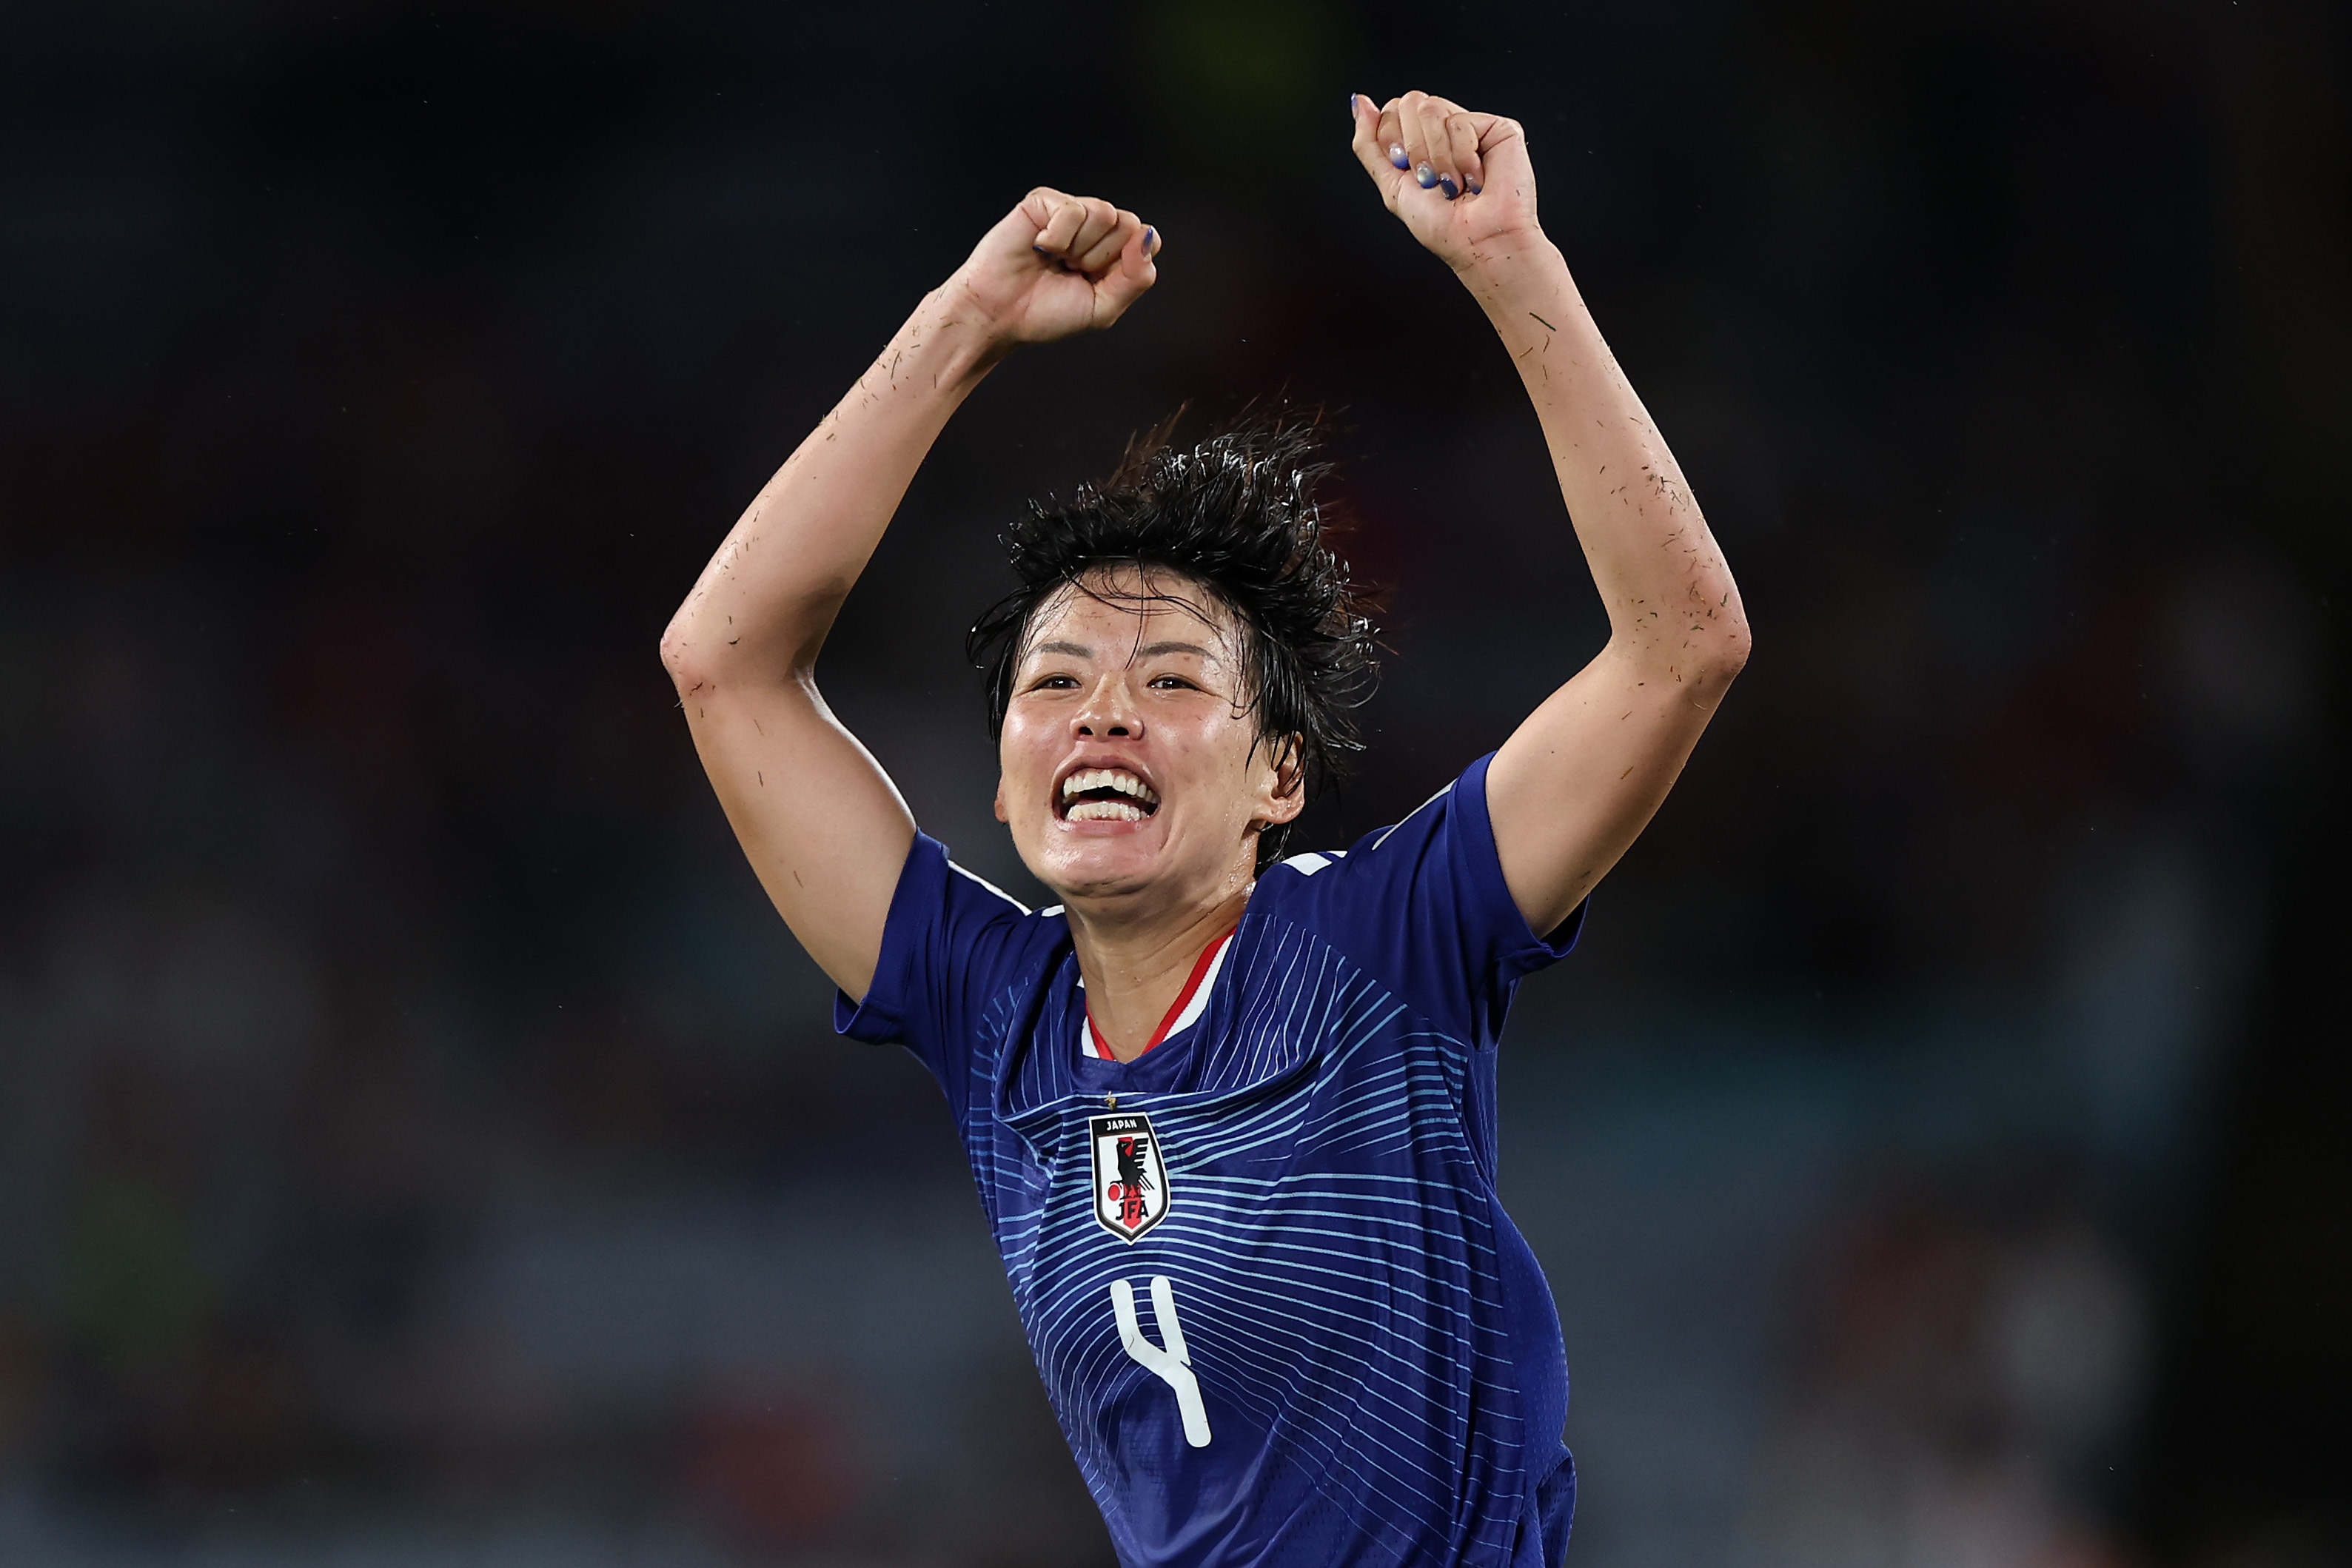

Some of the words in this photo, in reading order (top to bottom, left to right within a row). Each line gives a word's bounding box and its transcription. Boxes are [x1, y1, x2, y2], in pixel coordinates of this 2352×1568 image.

[1107, 1119, 1137, 1130] JAPAN
[1116, 1200, 1149, 1221] JFA
[1110, 1275, 1211, 1447] 4
